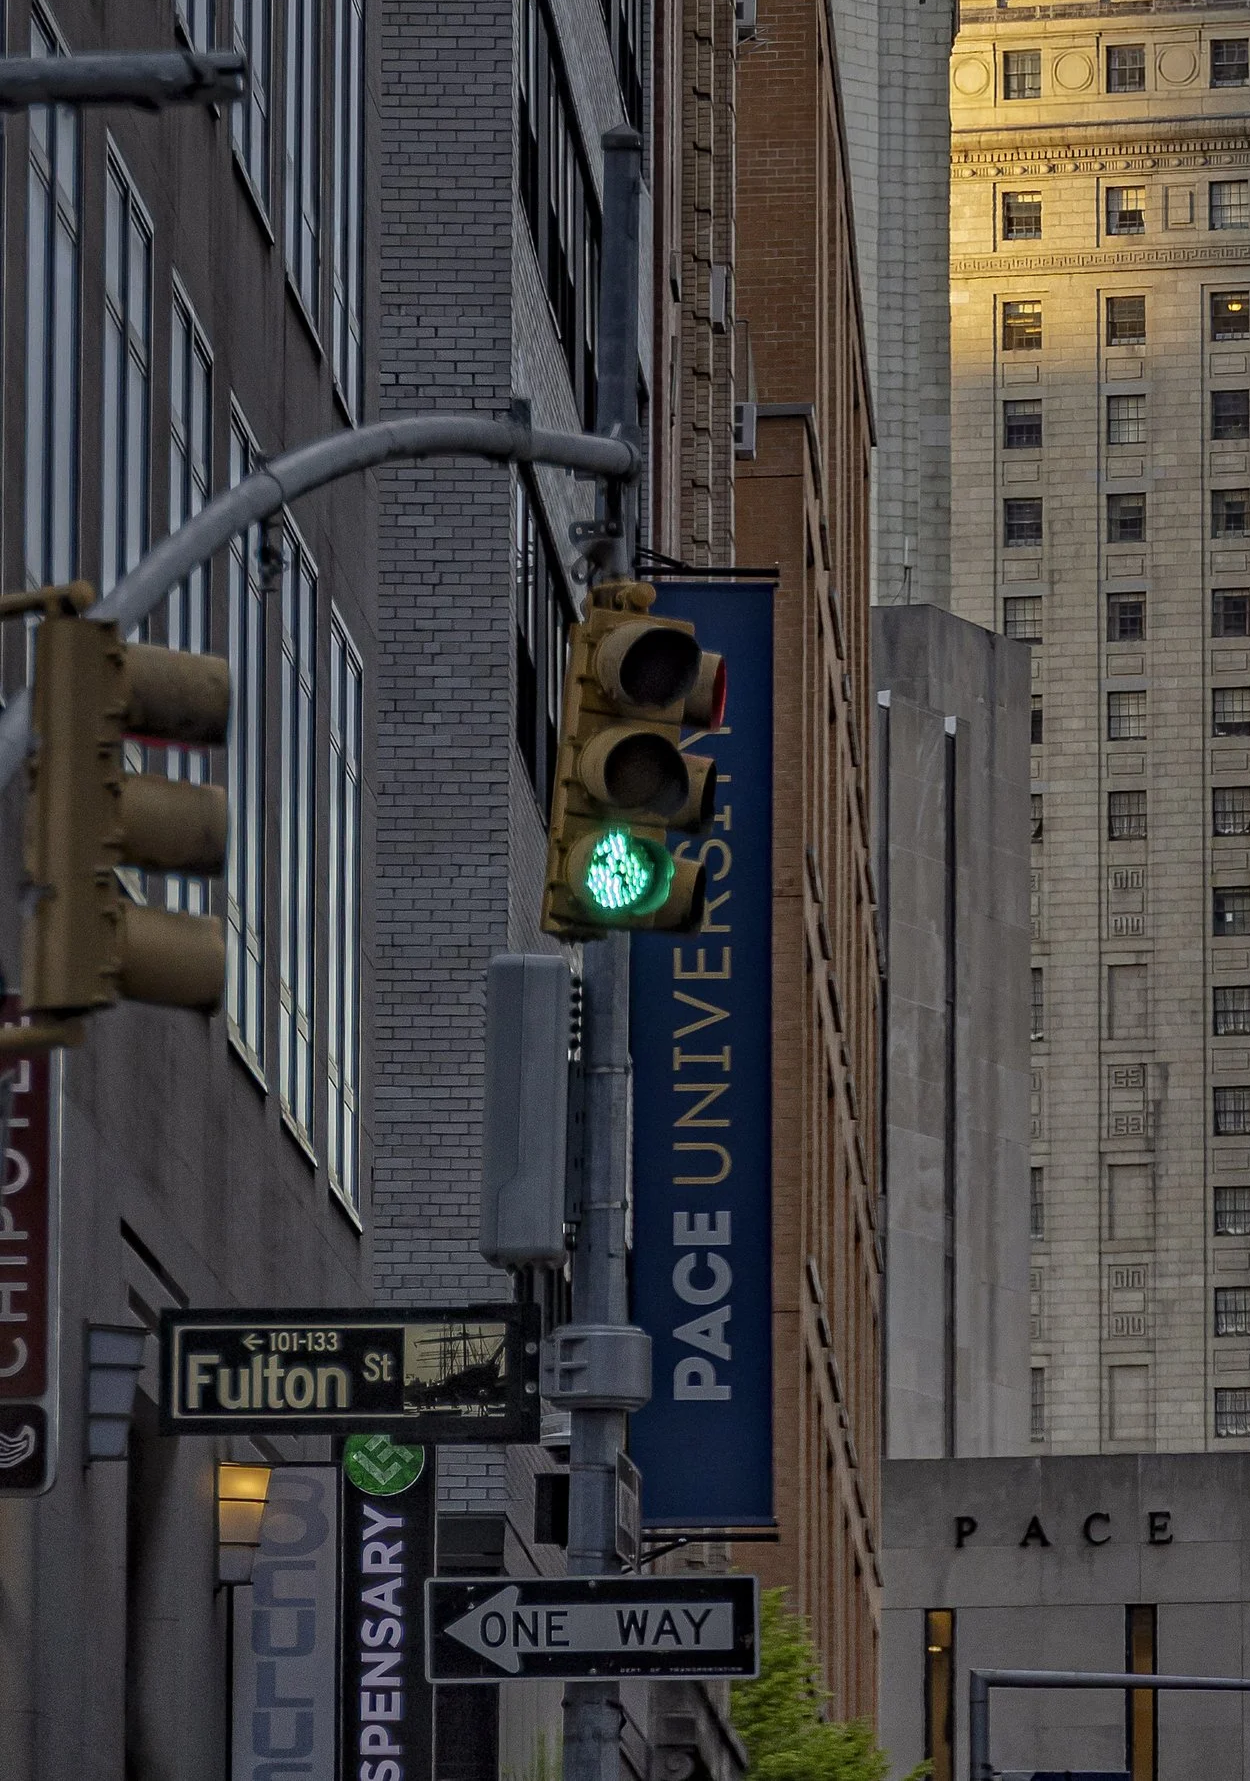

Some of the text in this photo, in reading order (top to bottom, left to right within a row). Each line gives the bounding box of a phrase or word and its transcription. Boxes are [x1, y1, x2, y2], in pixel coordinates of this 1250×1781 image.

[672, 1209, 733, 1402] PACE
[269, 1331, 340, 1353] 101-133
[186, 1352, 393, 1410] Fulton St
[953, 1510, 1175, 1549] PACE
[479, 1608, 713, 1649] ONE WAY
